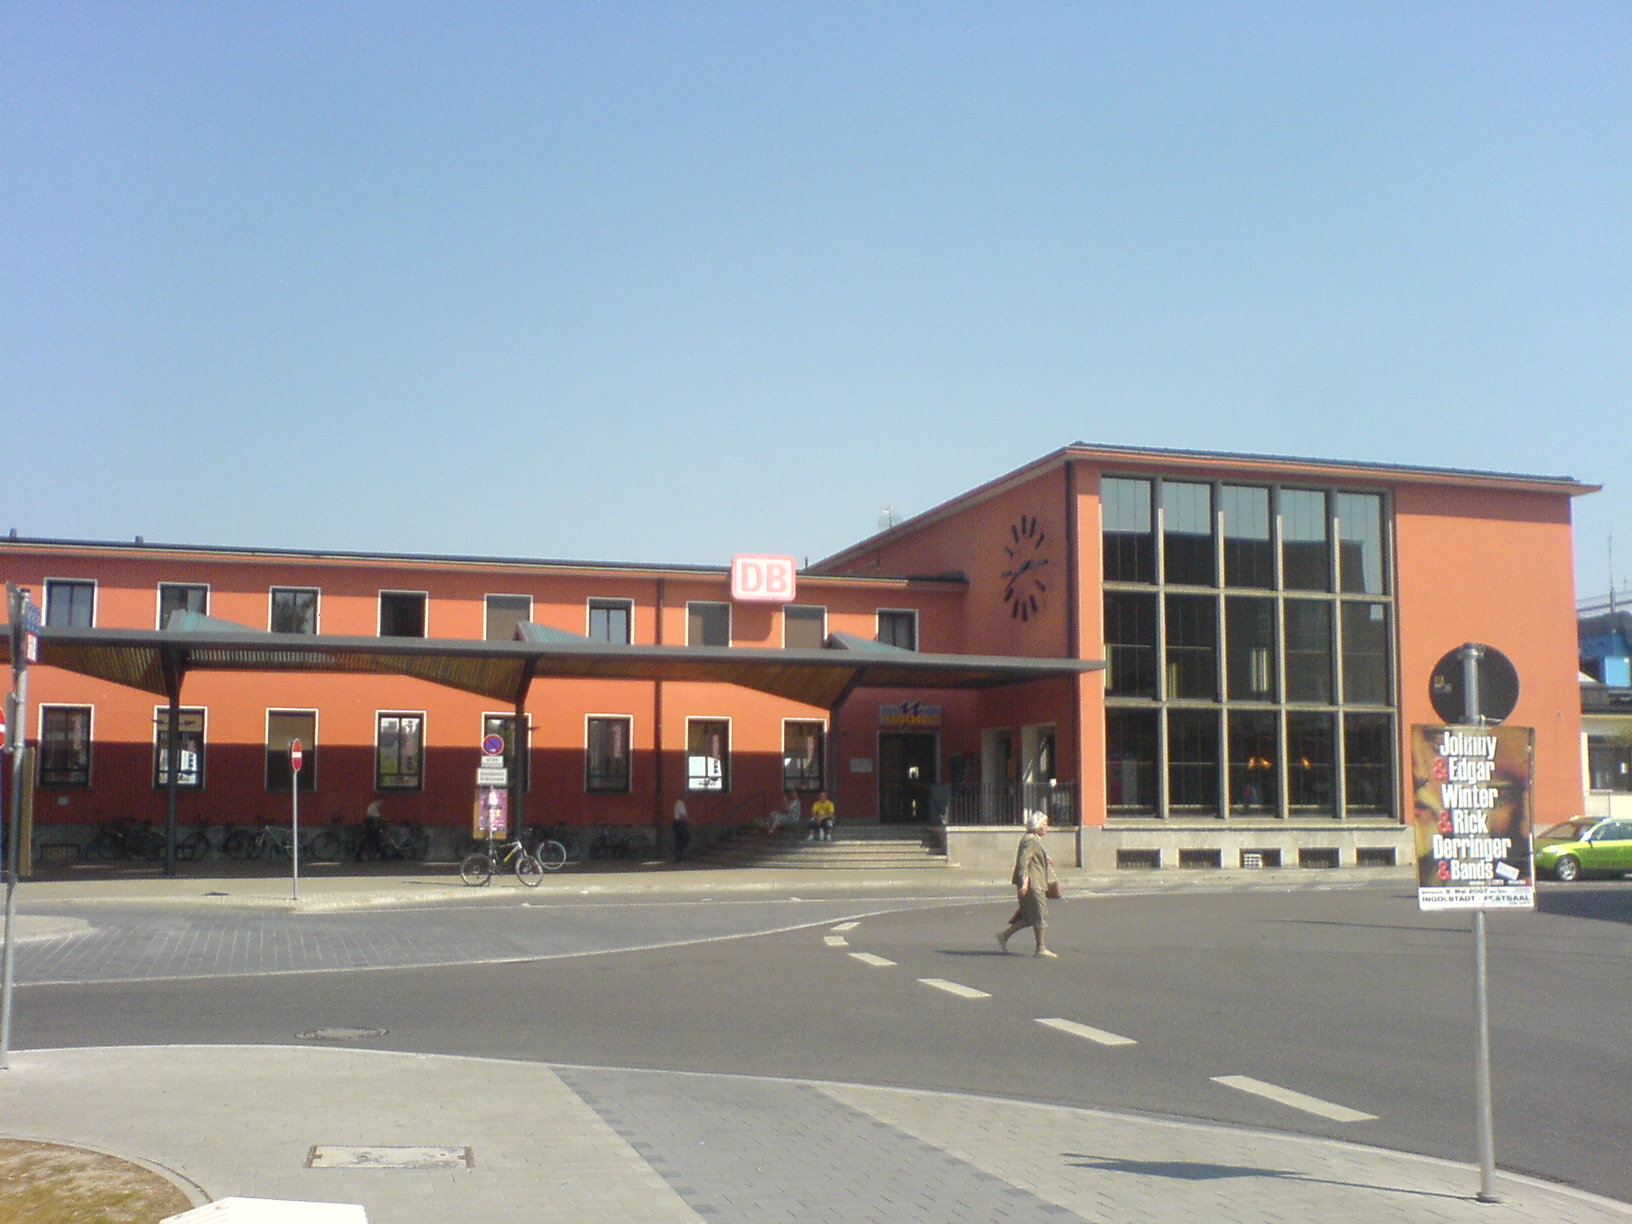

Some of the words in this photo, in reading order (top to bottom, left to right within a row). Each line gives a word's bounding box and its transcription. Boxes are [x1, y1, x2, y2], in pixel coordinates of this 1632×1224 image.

[741, 561, 788, 593] DB
[1440, 731, 1497, 760] Johnny
[1433, 757, 1448, 780] &
[1449, 757, 1495, 784] Edgar
[1441, 784, 1498, 809] Winter
[1436, 810, 1453, 833] &
[1453, 809, 1489, 834] Rick
[1433, 834, 1512, 861] Derringer
[1436, 861, 1451, 881] &
[1450, 859, 1494, 880] Bands
